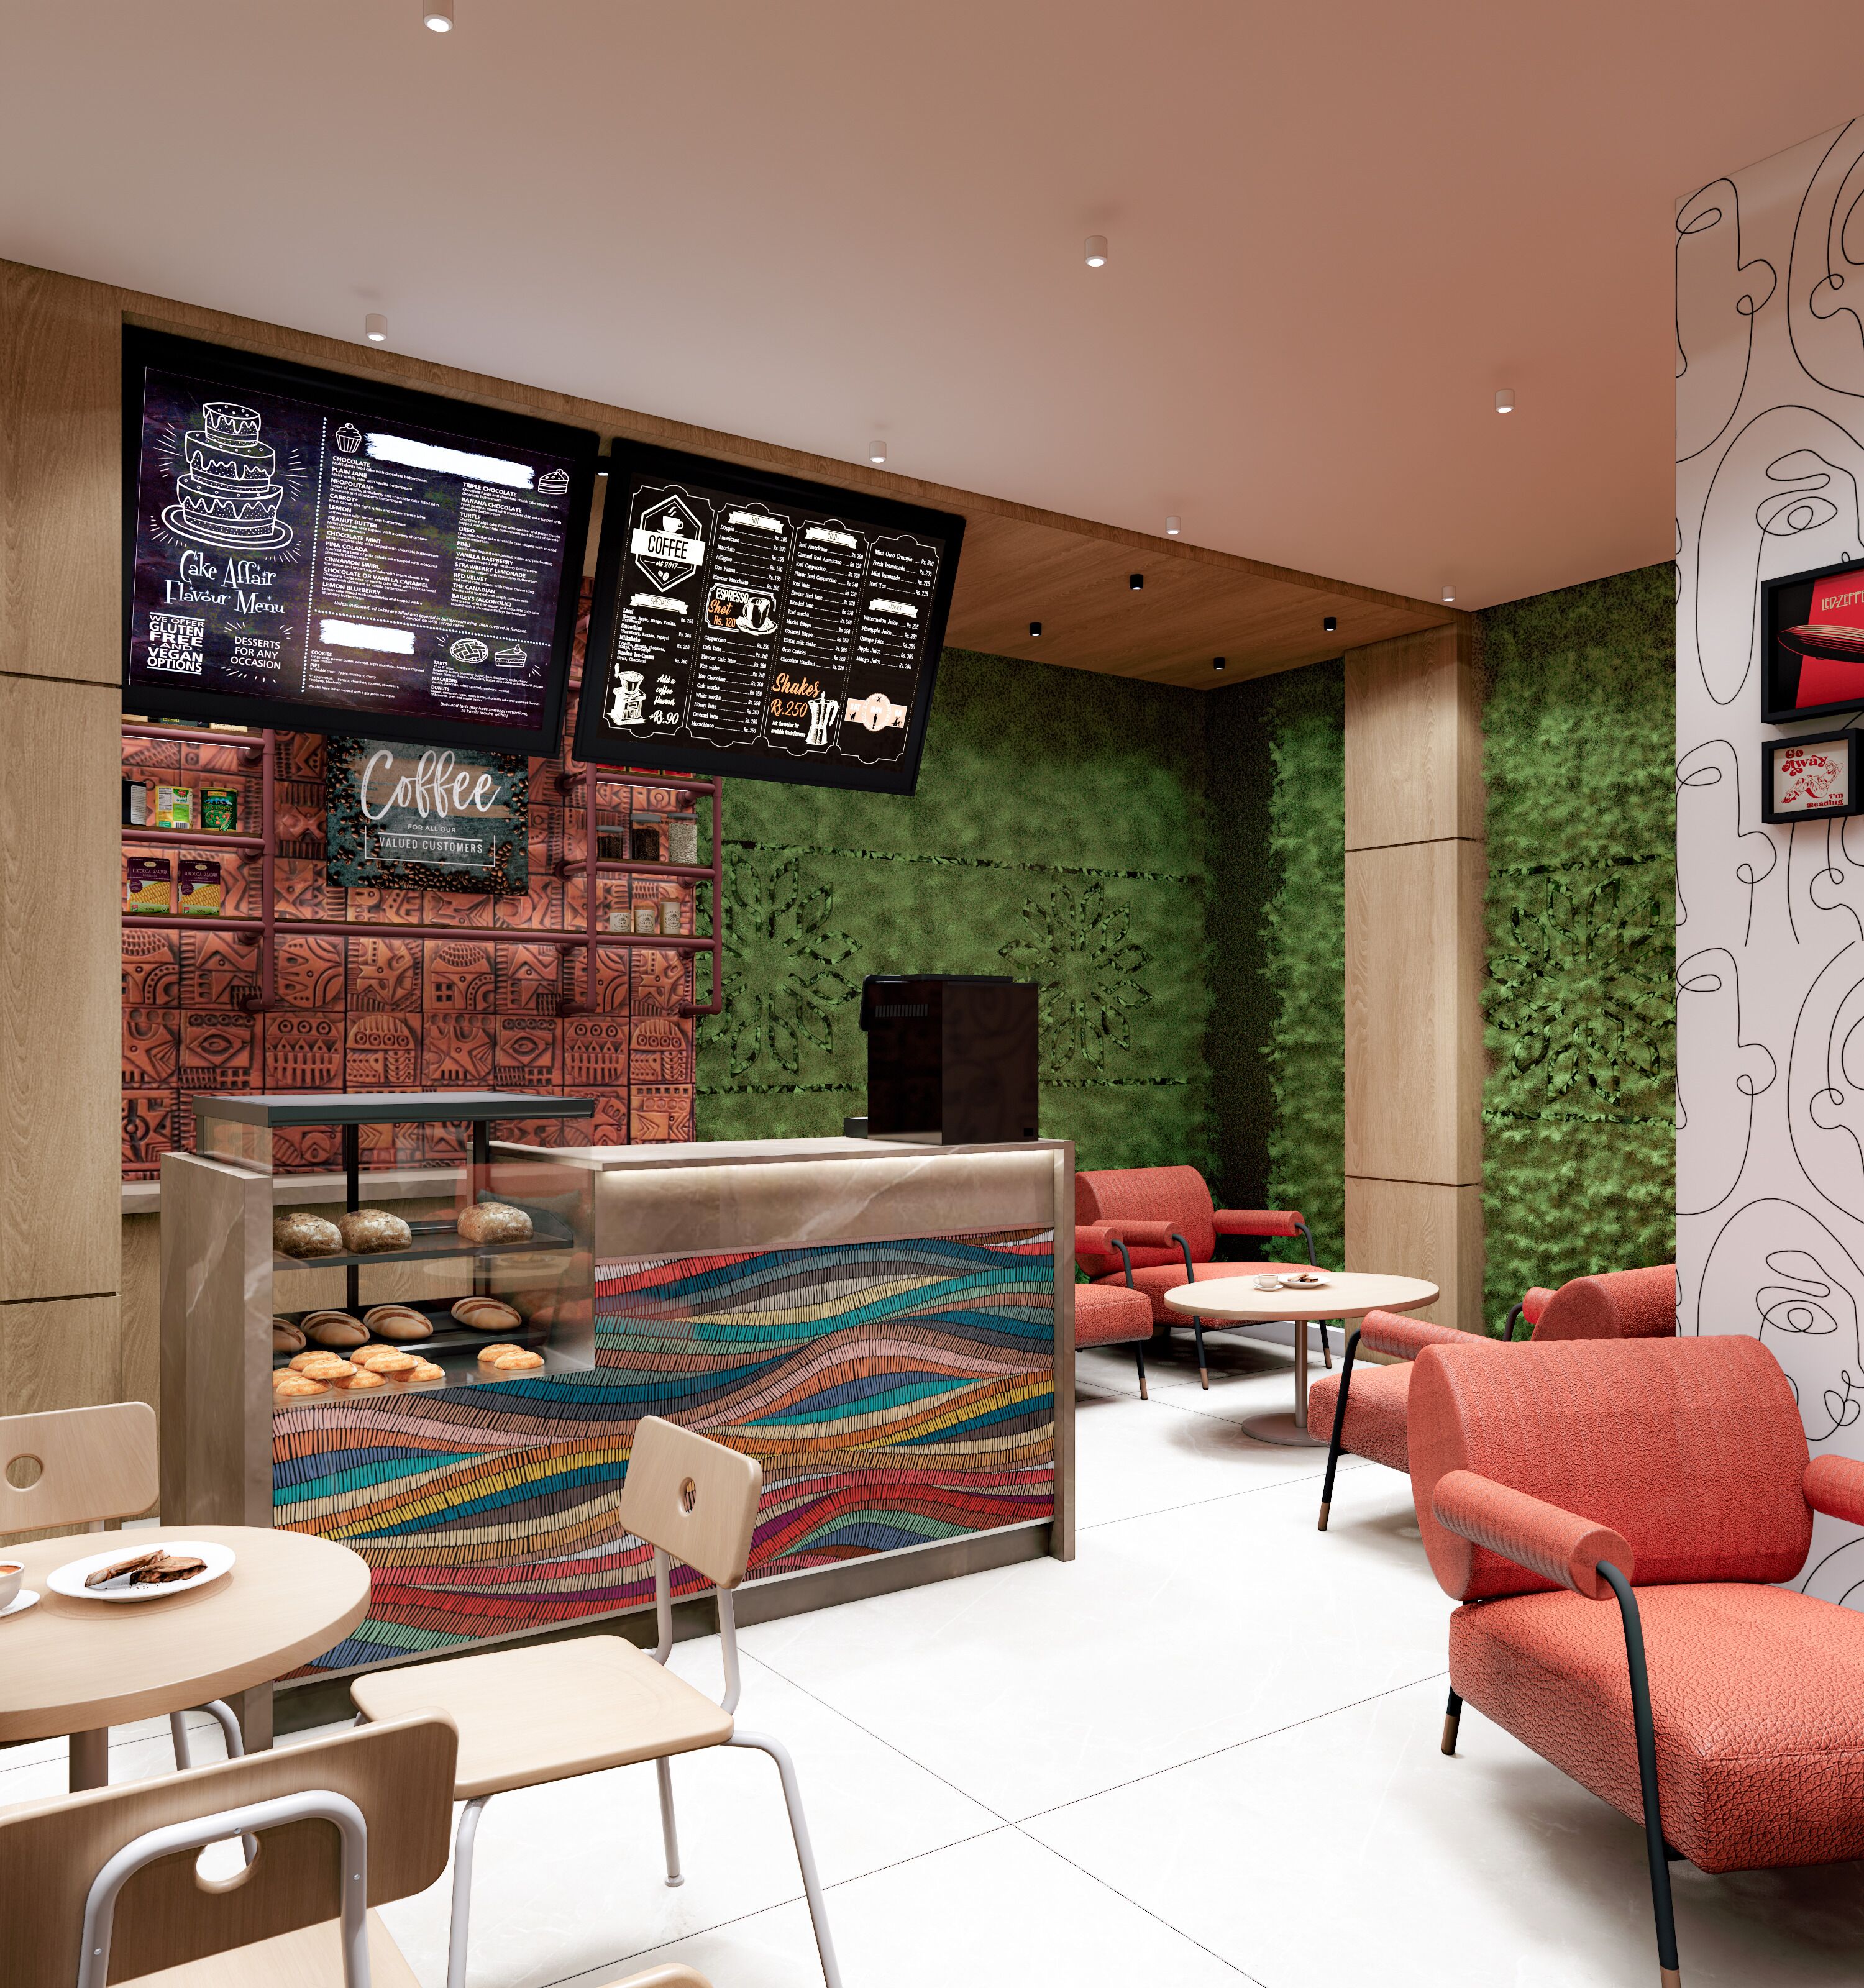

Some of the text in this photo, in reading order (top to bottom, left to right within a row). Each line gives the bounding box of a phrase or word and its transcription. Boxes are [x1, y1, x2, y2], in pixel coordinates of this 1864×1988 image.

[333, 456, 371, 467] CHOCOLATE
[483, 486, 517, 497] CHOCOLATE
[329, 504, 352, 513] LEMON
[462, 498, 523, 513] BANANA CHOCOLATE
[328, 516, 378, 528] PEANUT BUTTER
[327, 531, 364, 540] CHOCOLATE
[342, 544, 368, 552] COLADA
[648, 535, 688, 560] COFFEE
[325, 557, 360, 566] CINNAMON
[456, 552, 514, 565] VANILLA RASPBERRY
[180, 550, 276, 588] Cake Affair
[455, 562, 526, 578] STRAWBERRY LEMONADE
[324, 567, 362, 577] CHOCOLATE
[400, 580, 429, 588] CARAMEL
[347, 586, 381, 595] BLUEBERRY
[465, 585, 496, 593] CANADIAN
[715, 588, 749, 604] ESPRESSO
[164, 580, 285, 614] Flavour Menu
[708, 599, 734, 615] Shot
[150, 621, 204, 637] GLUTEN
[171, 618, 204, 627] OFFER
[150, 631, 203, 647] FREE
[235, 636, 280, 649] DESSERTS
[148, 647, 203, 662] VEGAN
[235, 647, 279, 659] FOR ANY
[147, 657, 202, 672] OPTIONS
[231, 657, 281, 669] OCCASION
[772, 673, 821, 698] Shakes
[1785, 749, 1804, 759] Go
[1781, 755, 1828, 777] Away
[361, 750, 501, 820] Coffee
[1806, 799, 1843, 808] Reading
[379, 837, 483, 854] VALUED CUSTOMERS
